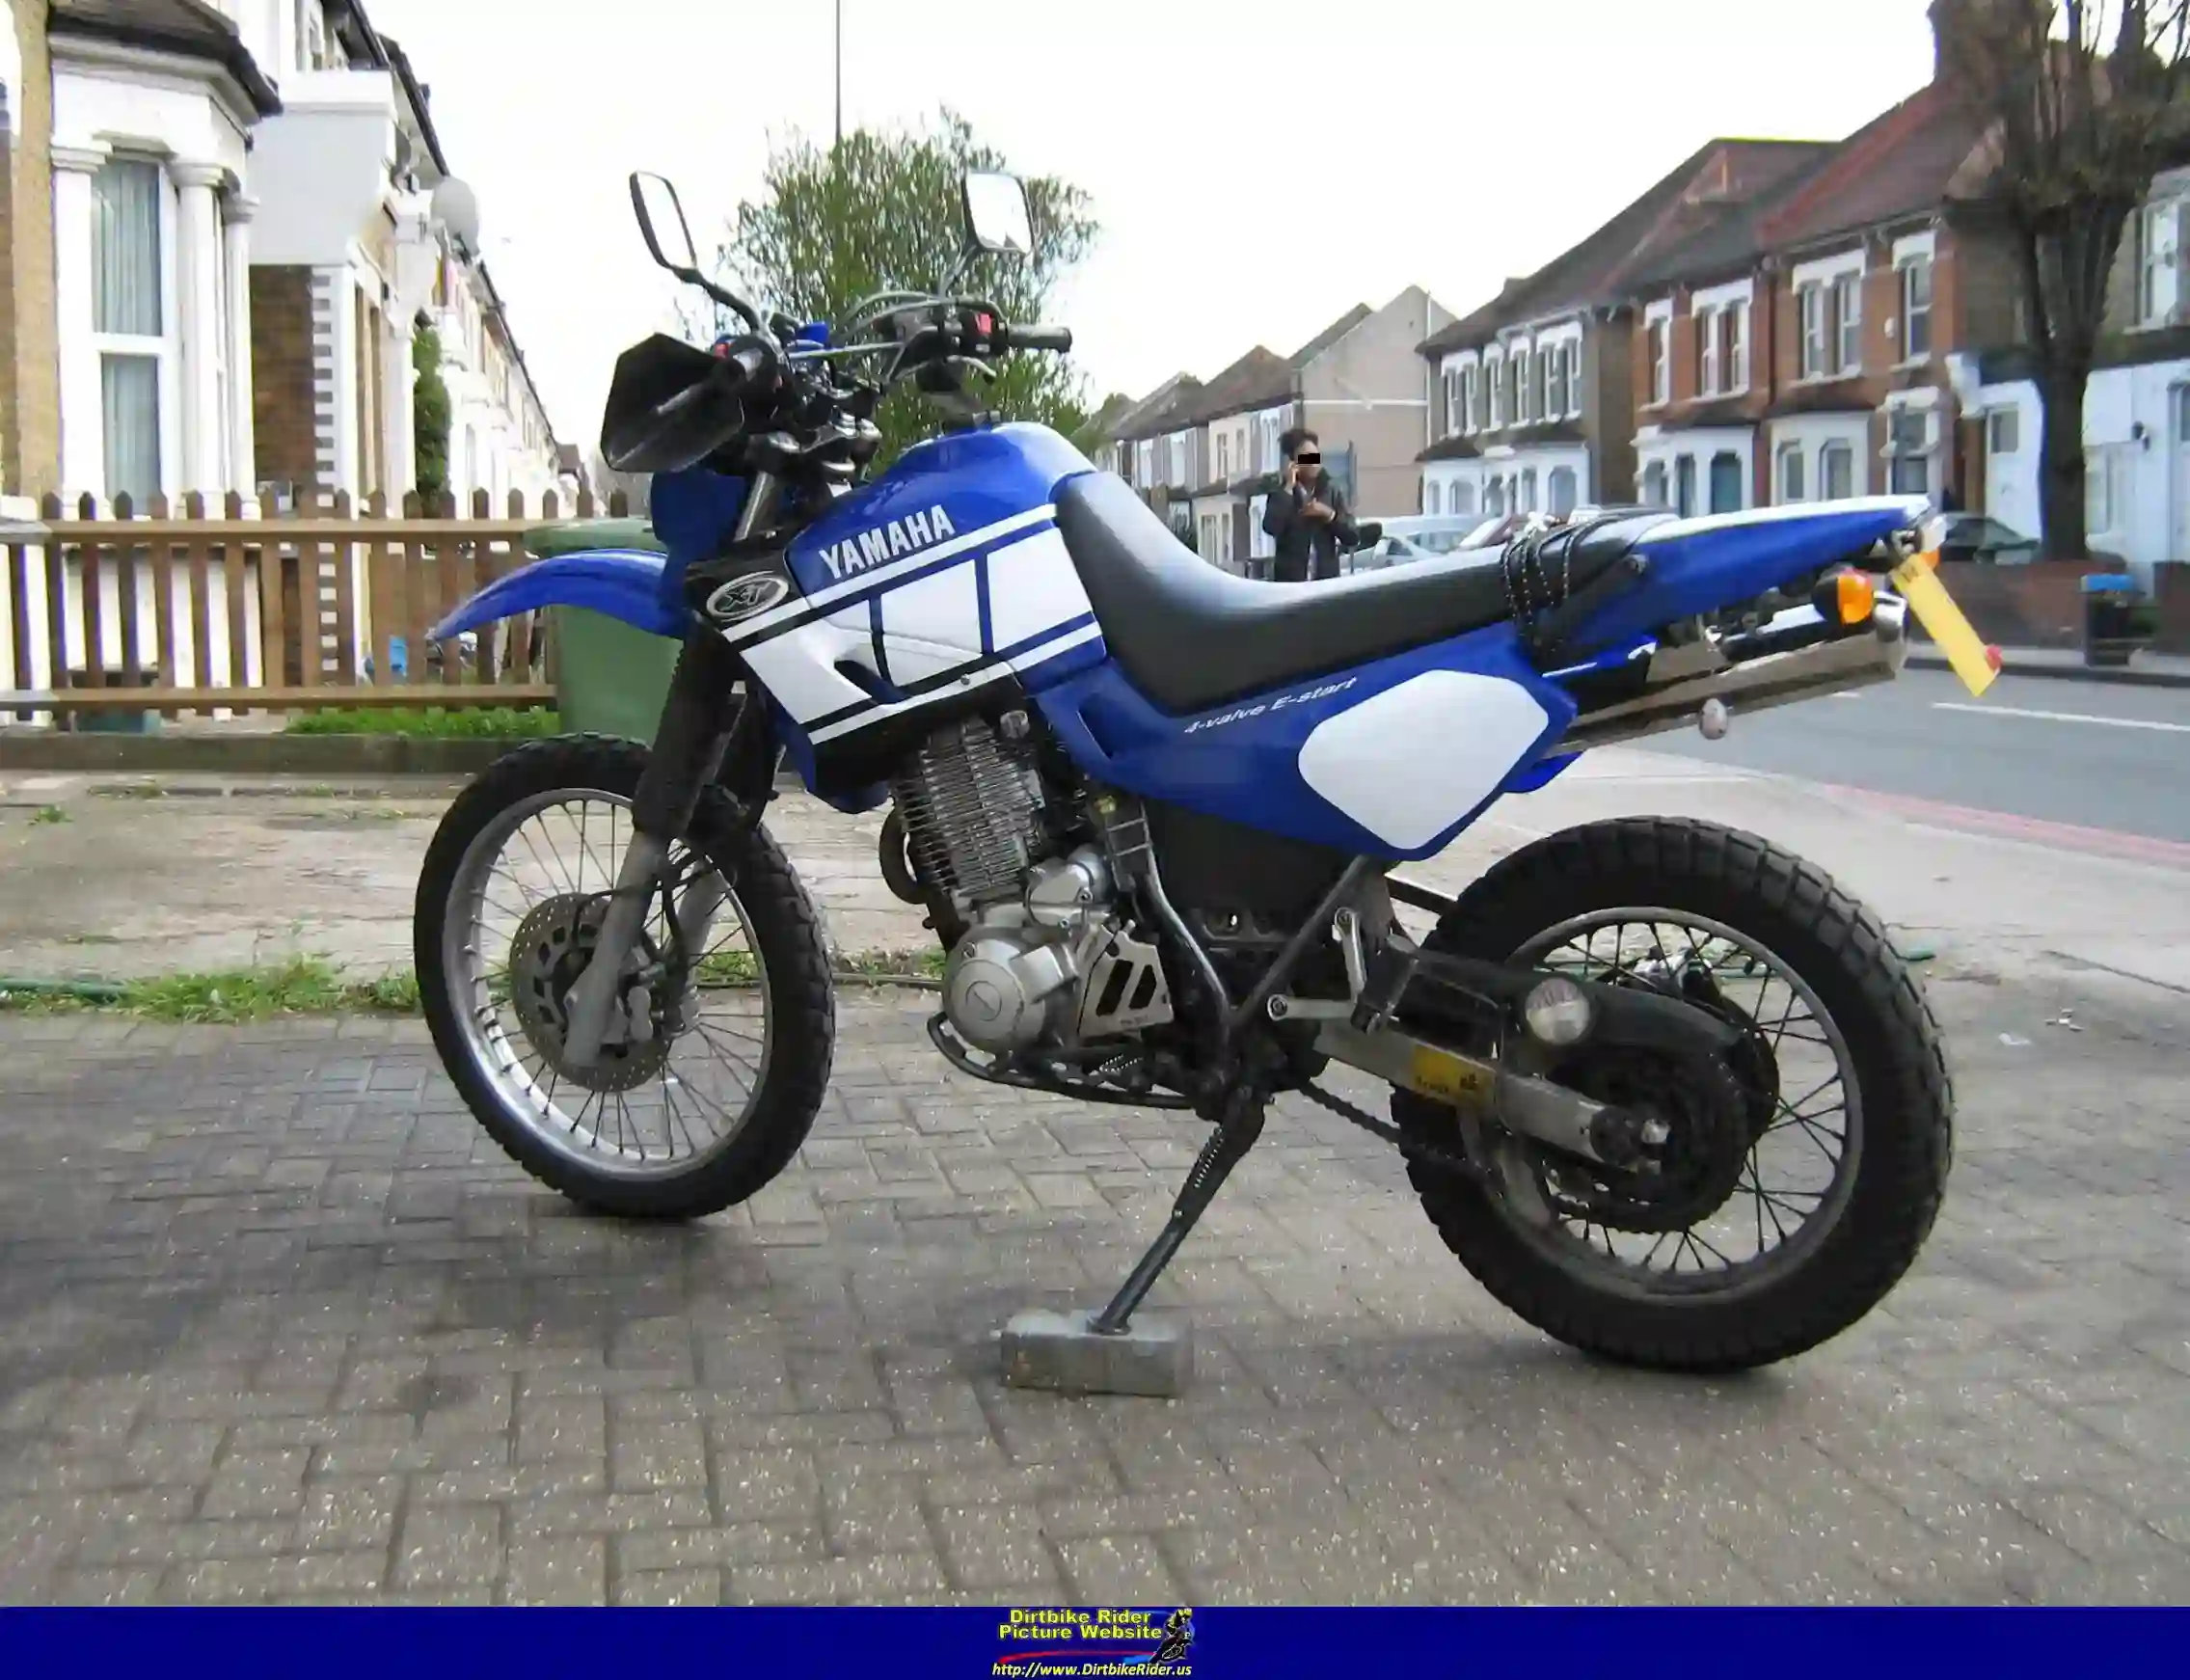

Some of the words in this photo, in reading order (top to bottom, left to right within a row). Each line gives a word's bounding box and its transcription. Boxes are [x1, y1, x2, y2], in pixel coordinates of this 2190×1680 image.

[818, 503, 956, 579] YAMAHA
[1183, 704, 1266, 734] 4-valve
[1269, 676, 1358, 712] E-start
